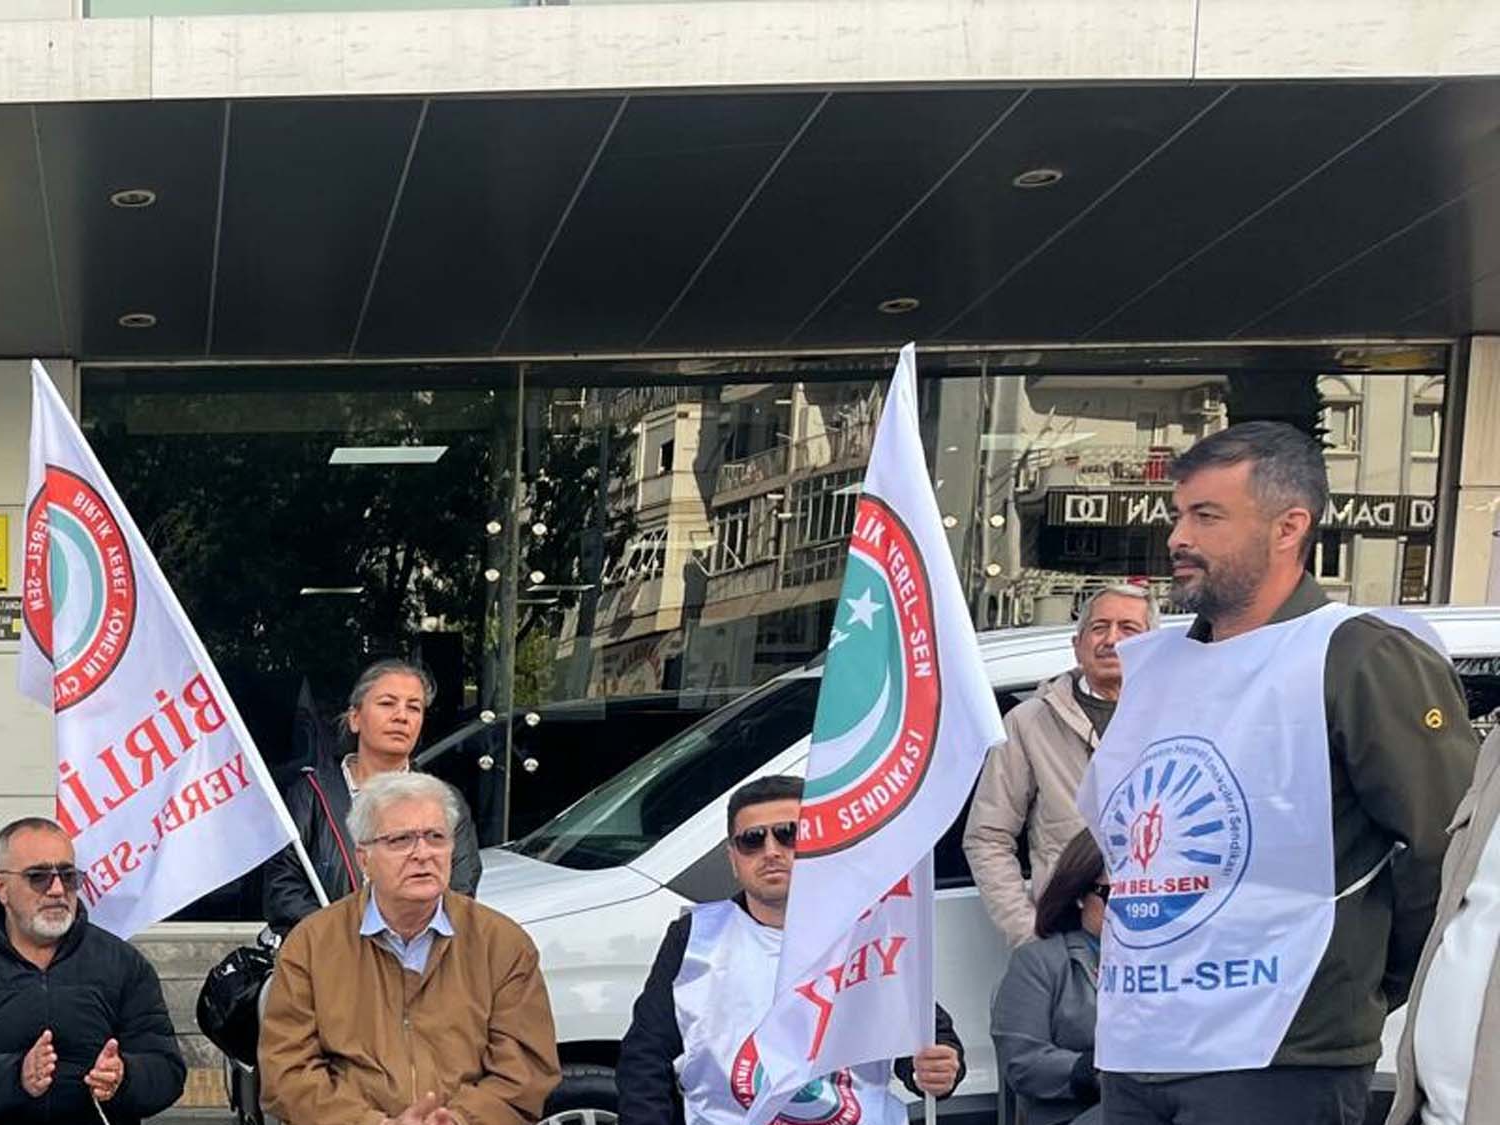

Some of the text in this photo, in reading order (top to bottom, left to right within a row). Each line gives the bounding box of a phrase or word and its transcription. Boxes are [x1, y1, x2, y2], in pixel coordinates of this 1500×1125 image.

[886, 539, 932, 679] YEREL-SEN
[838, 728, 925, 830] SENDİKASI
[1125, 901, 1160, 918] 1990
[1122, 955, 1280, 994] BEL-SEN
